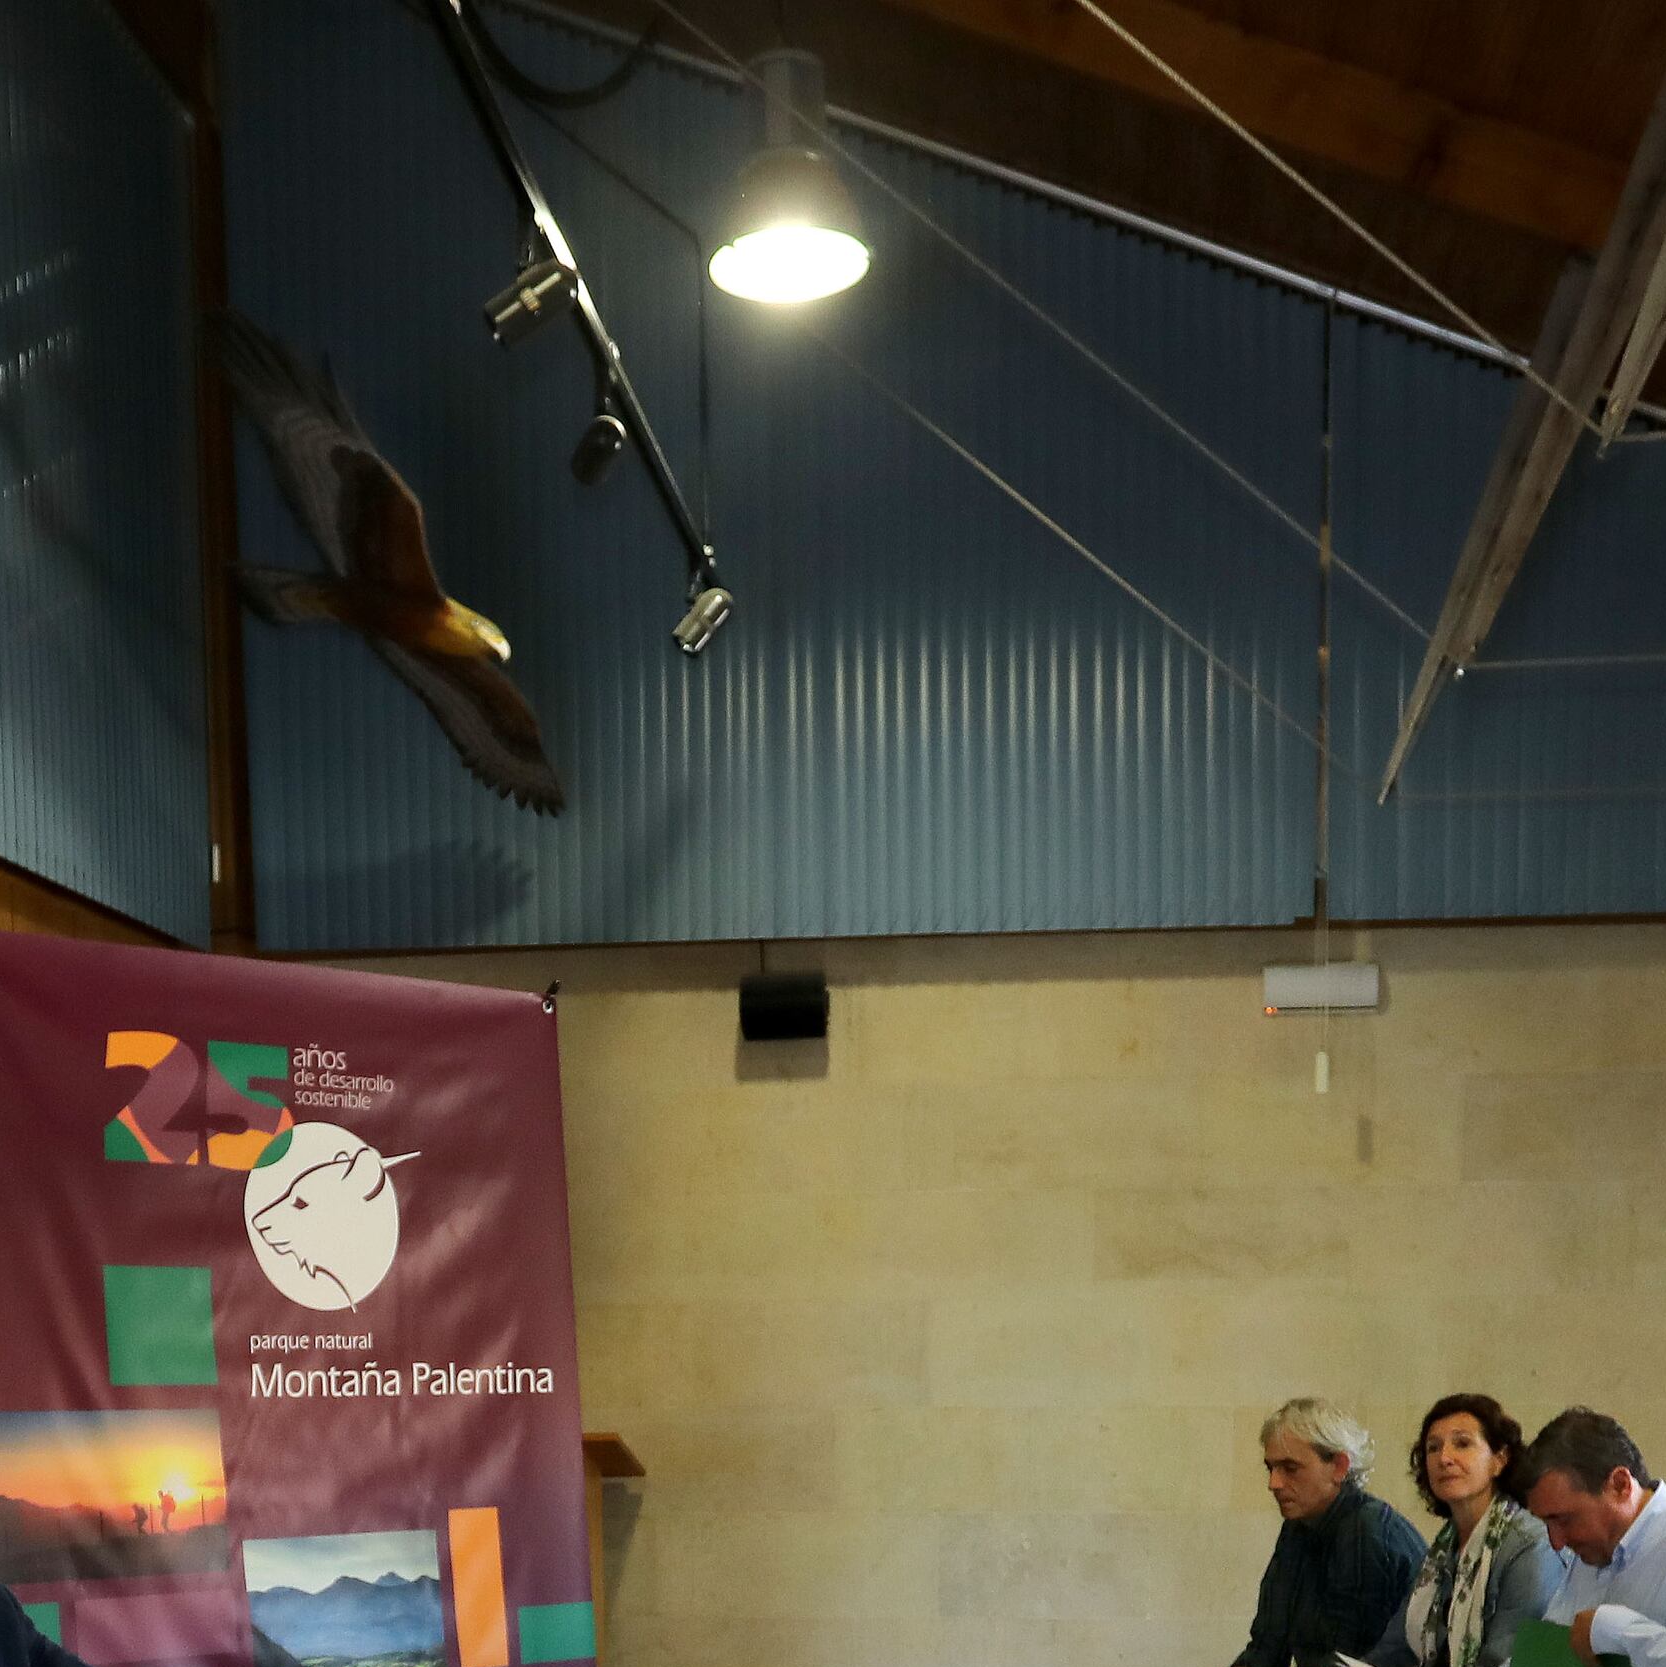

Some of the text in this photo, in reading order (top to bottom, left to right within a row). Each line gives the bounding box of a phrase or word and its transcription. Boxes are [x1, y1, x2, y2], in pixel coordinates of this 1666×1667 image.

[292, 1043, 348, 1071] años
[293, 1069, 395, 1093] de desarrollo
[103, 1030, 295, 1171] 25
[293, 1090, 373, 1110] sostenible
[250, 1332, 373, 1353] parque natural
[250, 1361, 555, 1398] Montaña Palentina
